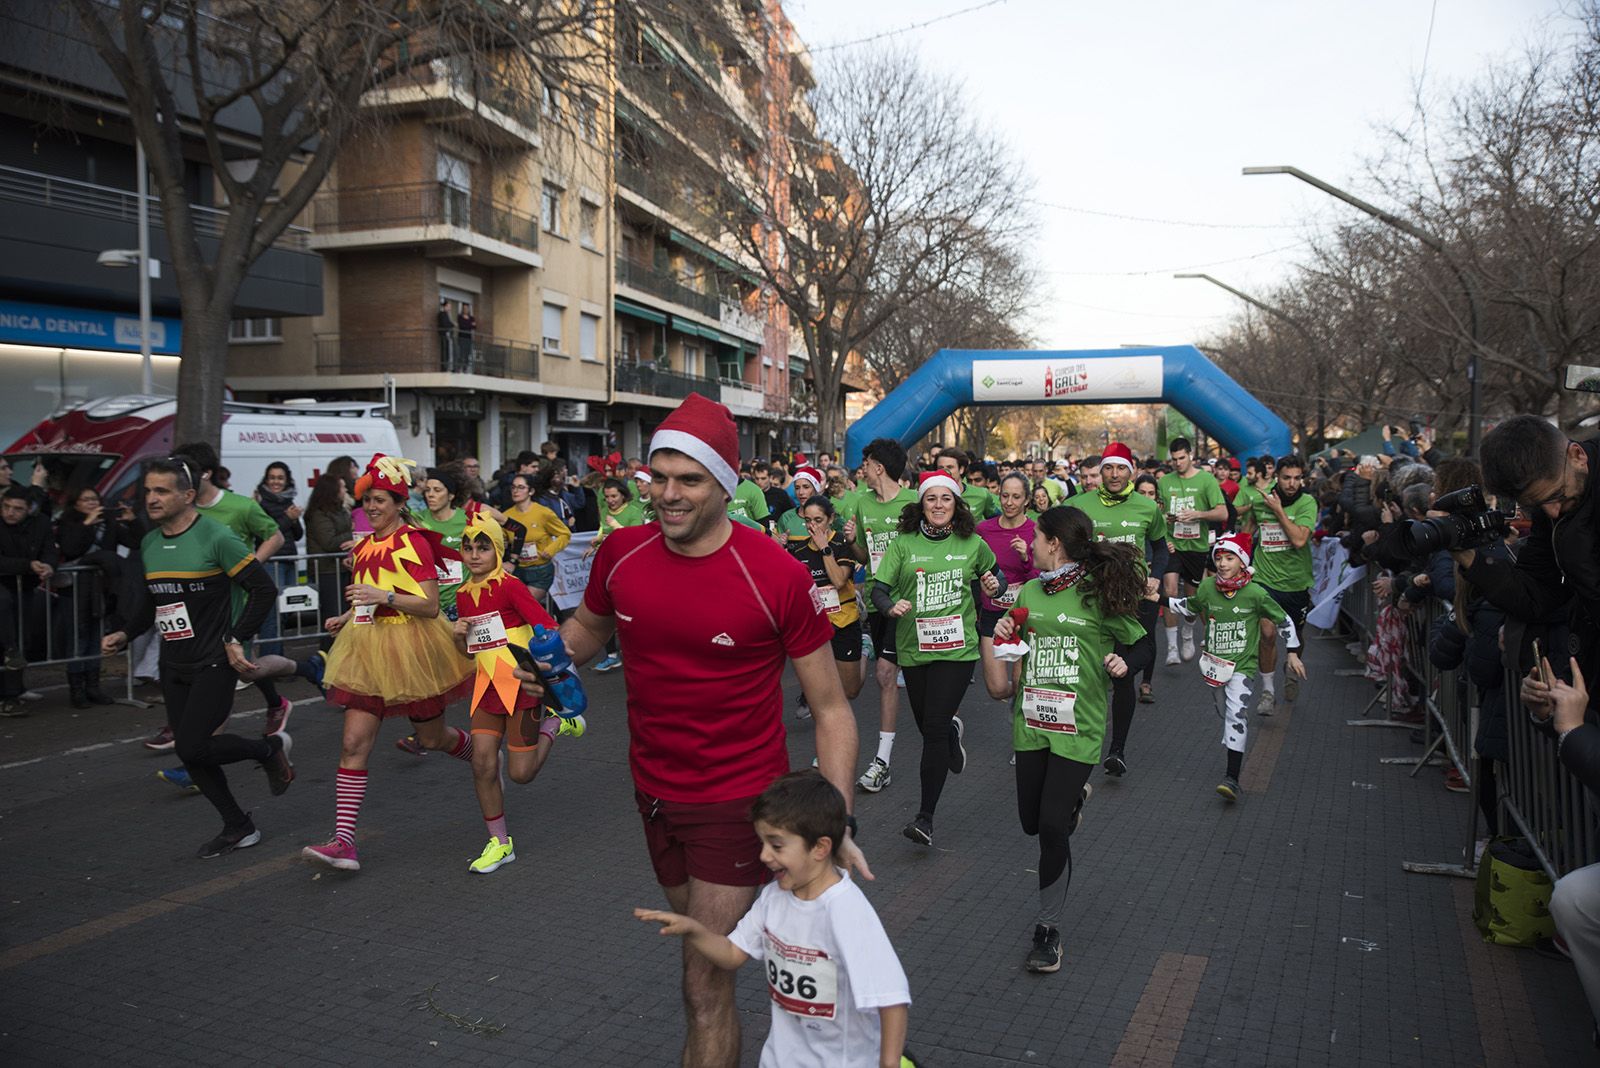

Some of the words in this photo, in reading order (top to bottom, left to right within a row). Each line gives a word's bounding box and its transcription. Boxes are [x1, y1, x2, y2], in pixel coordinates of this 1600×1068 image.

[45, 319, 107, 336] DENTAL
[1055, 366, 1074, 377] CURSA
[1055, 374, 1079, 389] GALL
[1055, 388, 1069, 396] SANT
[1070, 384, 1088, 393] CUGAT
[927, 570, 951, 583] CURSA
[952, 568, 963, 579] DEL
[926, 579, 955, 597] GALL
[926, 595, 943, 606] SANT
[1217, 622, 1235, 631] CURSA
[1236, 620, 1246, 630] DEL
[474, 628, 490, 637] LUCAS
[478, 634, 491, 643] 428
[1216, 630, 1238, 642] GALL
[932, 635, 950, 643] 549
[1038, 636, 1061, 649] CURSA
[1063, 635, 1078, 648] DEL
[1215, 642, 1229, 650] SANT
[1037, 648, 1067, 667] GALL
[1036, 667, 1053, 679] SANT
[1054, 664, 1080, 677] CUGAT
[1036, 704, 1058, 715] BRUNA
[1039, 713, 1058, 723] 550
[767, 959, 817, 1000] 936
